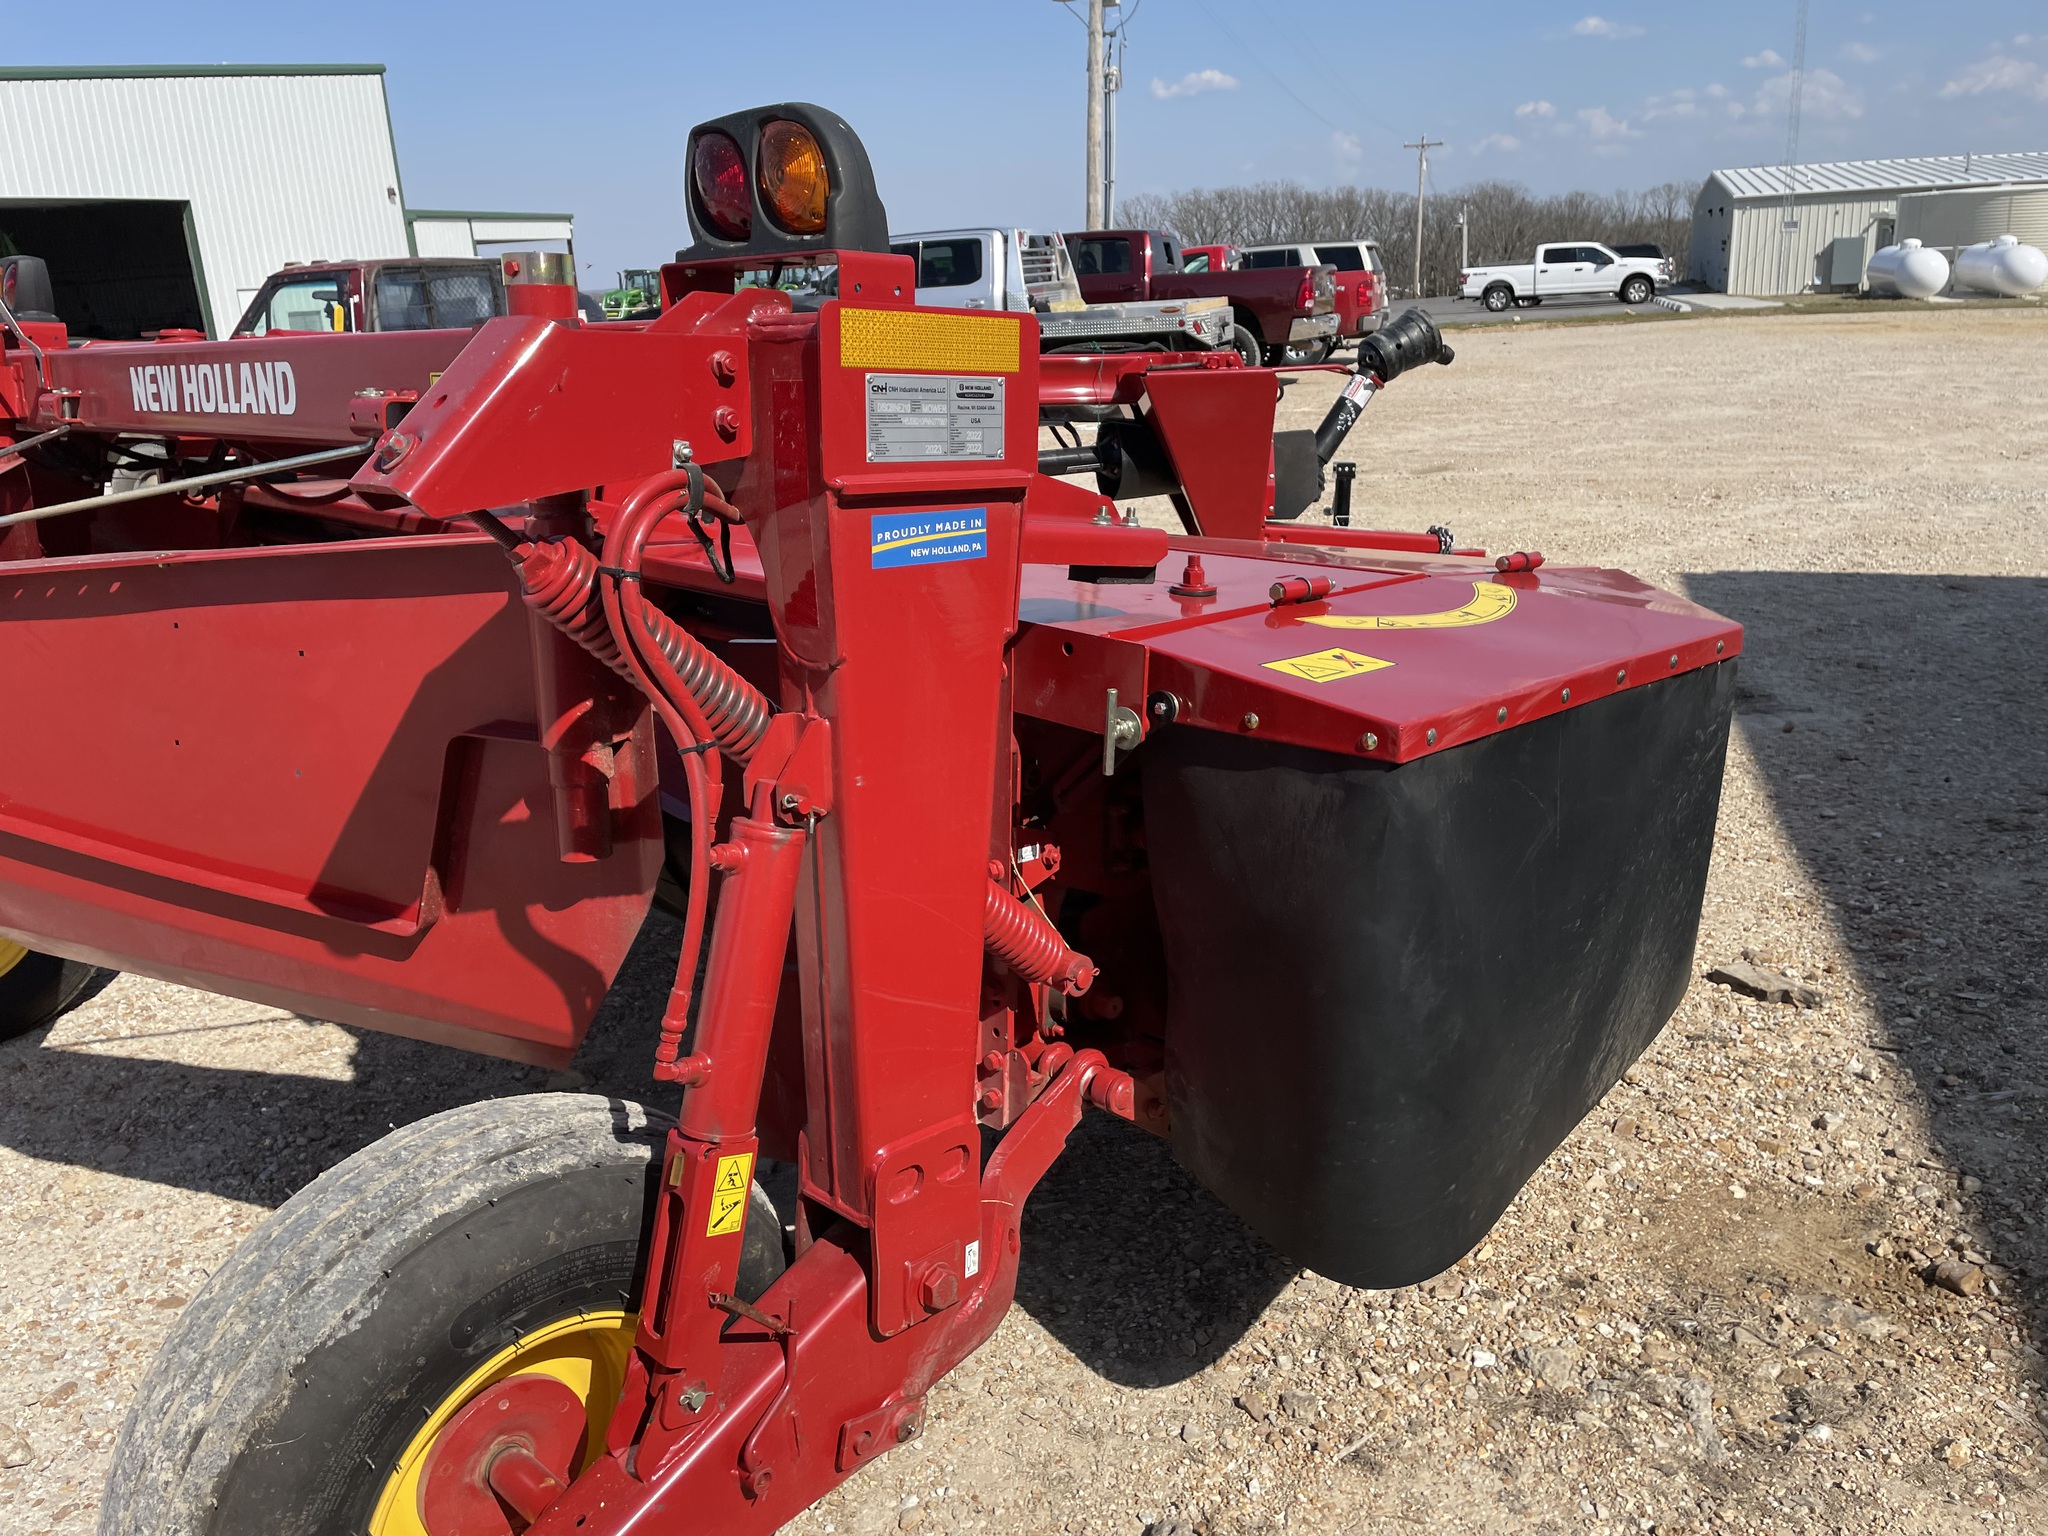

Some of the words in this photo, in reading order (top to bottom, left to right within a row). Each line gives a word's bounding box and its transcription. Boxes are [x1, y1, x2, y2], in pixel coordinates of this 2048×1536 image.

[129, 364, 178, 413] NEW
[180, 361, 297, 415] HOLLAND
[966, 430, 982, 440] 2022
[925, 444, 942, 454] 2023
[966, 443, 982, 453] 2022
[877, 524, 931, 543] PROUDLY
[936, 520, 966, 532] MADE
[971, 519, 982, 528] IN
[910, 547, 930, 558] NEW
[931, 544, 971, 556] HOLLAND,
[972, 542, 982, 551] PA
